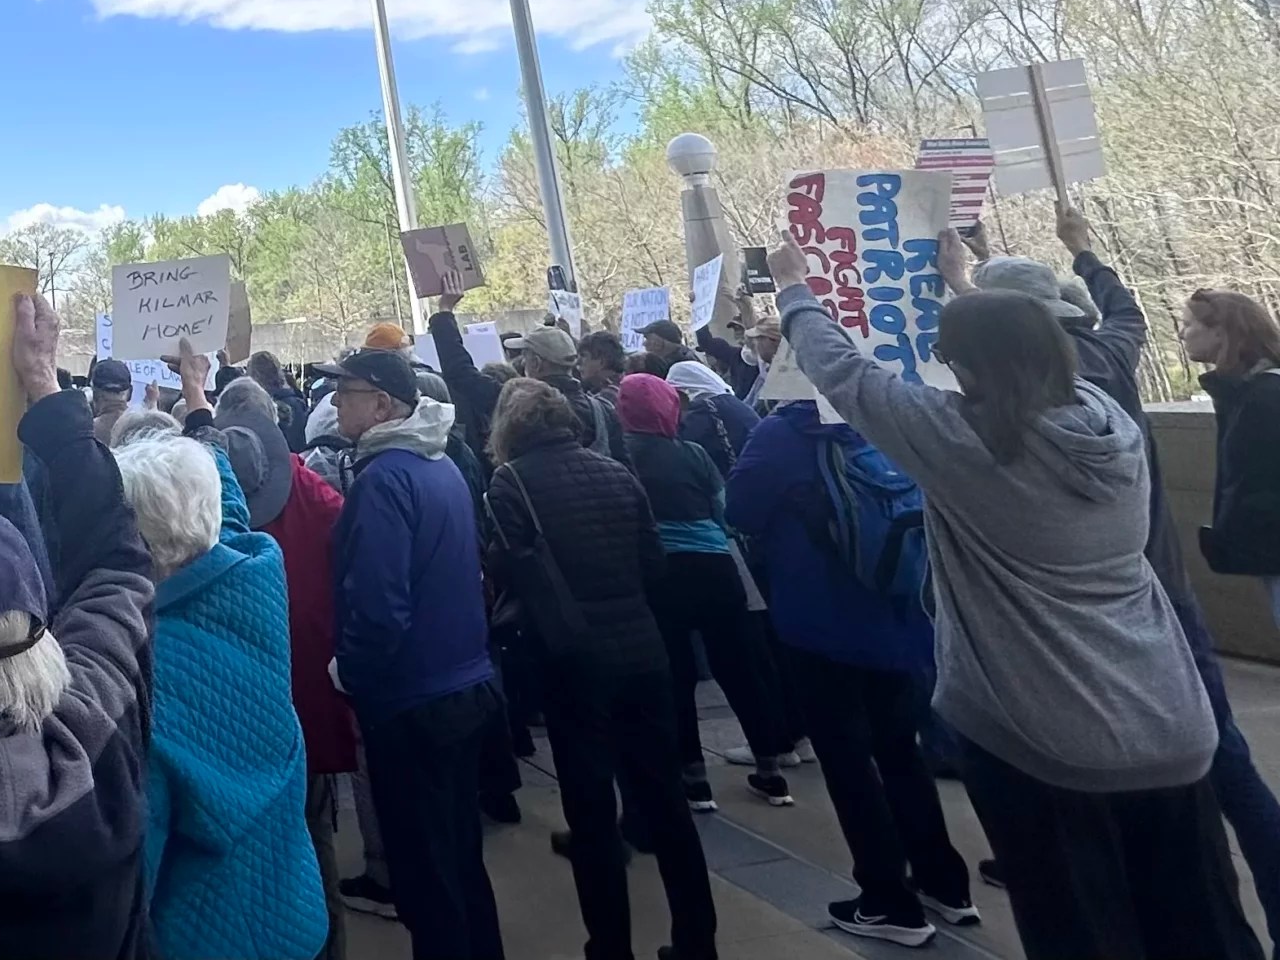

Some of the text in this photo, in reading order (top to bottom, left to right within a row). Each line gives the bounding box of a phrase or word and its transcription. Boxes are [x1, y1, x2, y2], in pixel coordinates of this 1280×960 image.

[126, 266, 199, 291] BRING
[138, 290, 219, 314] KILMAR
[825, 226, 869, 338] FIGHT
[856, 173, 924, 385] PATRIOT
[902, 238, 946, 363] REAL
[143, 365, 156, 376] OF
